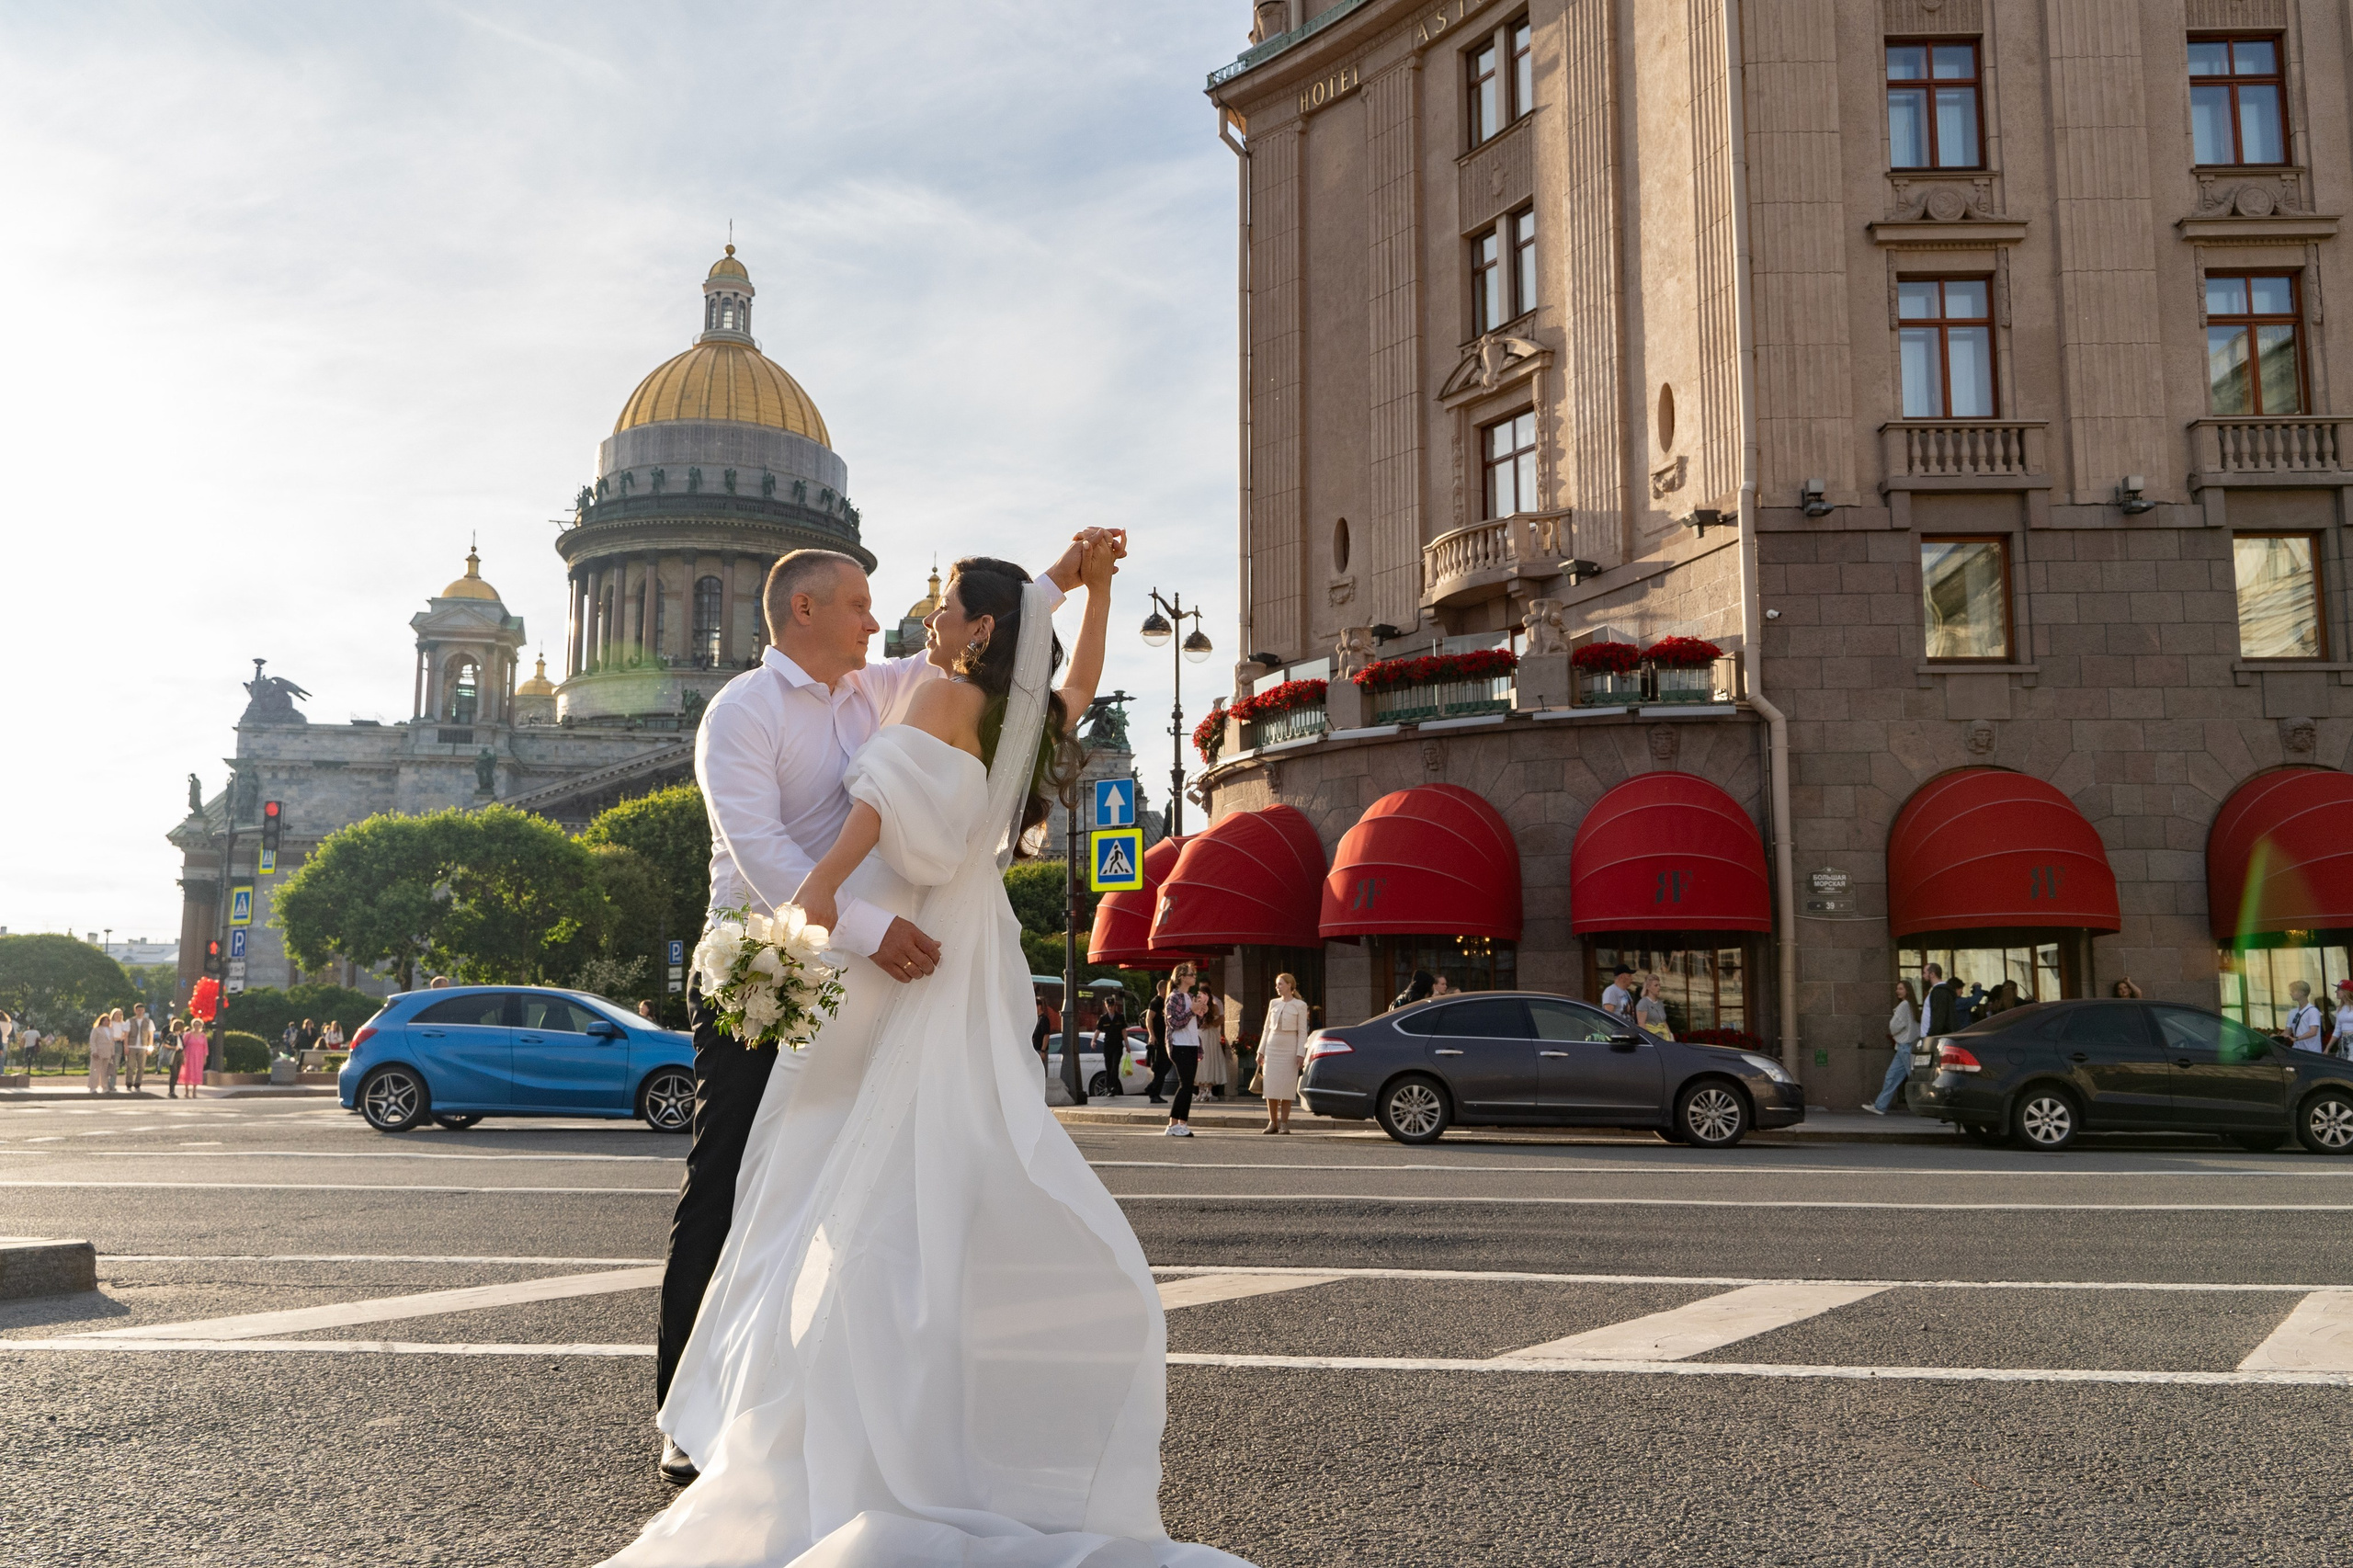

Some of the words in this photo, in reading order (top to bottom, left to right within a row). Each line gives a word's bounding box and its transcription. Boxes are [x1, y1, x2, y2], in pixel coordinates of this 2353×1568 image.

[1300, 64, 1358, 113] HOTEL
[1416, 0, 1485, 41] AST
[1825, 902, 1836, 910] 39
